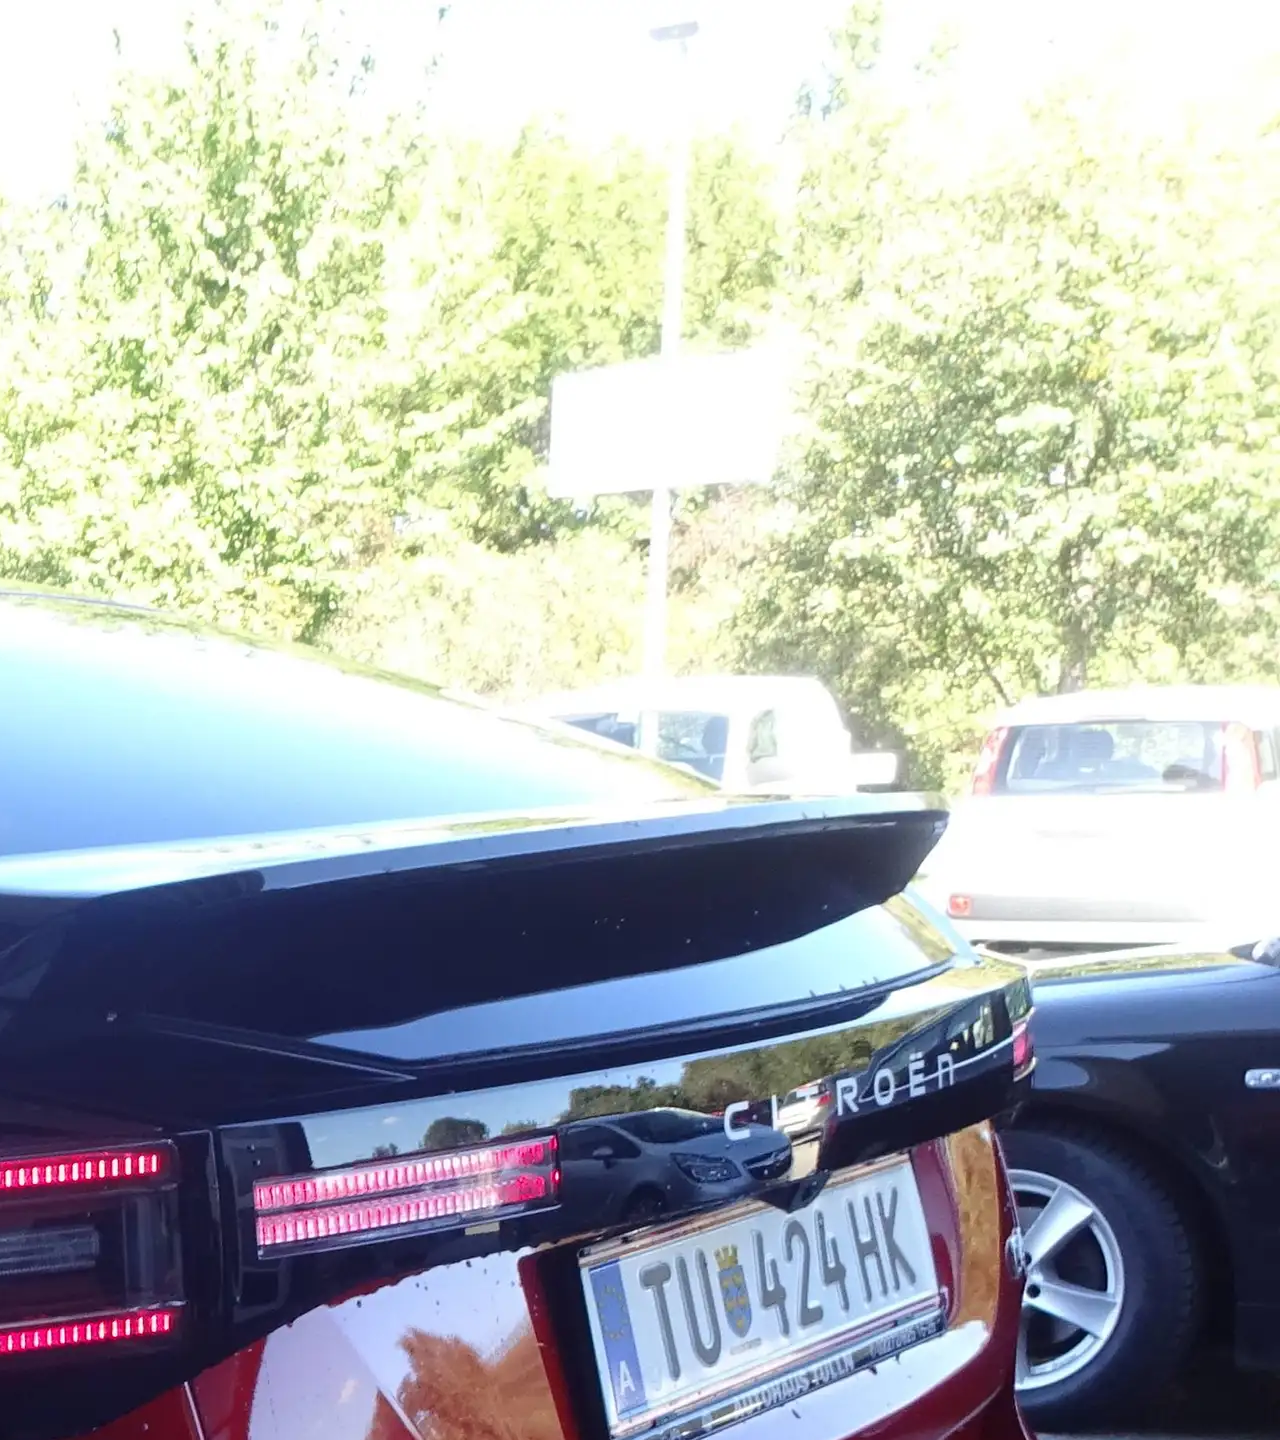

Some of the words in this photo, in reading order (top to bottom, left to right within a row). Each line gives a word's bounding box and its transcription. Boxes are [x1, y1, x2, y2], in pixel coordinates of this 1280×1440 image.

[639, 1248, 722, 1381] TU
[750, 1209, 850, 1337] 424
[846, 1183, 916, 1302] HK
[617, 1361, 636, 1395] A
